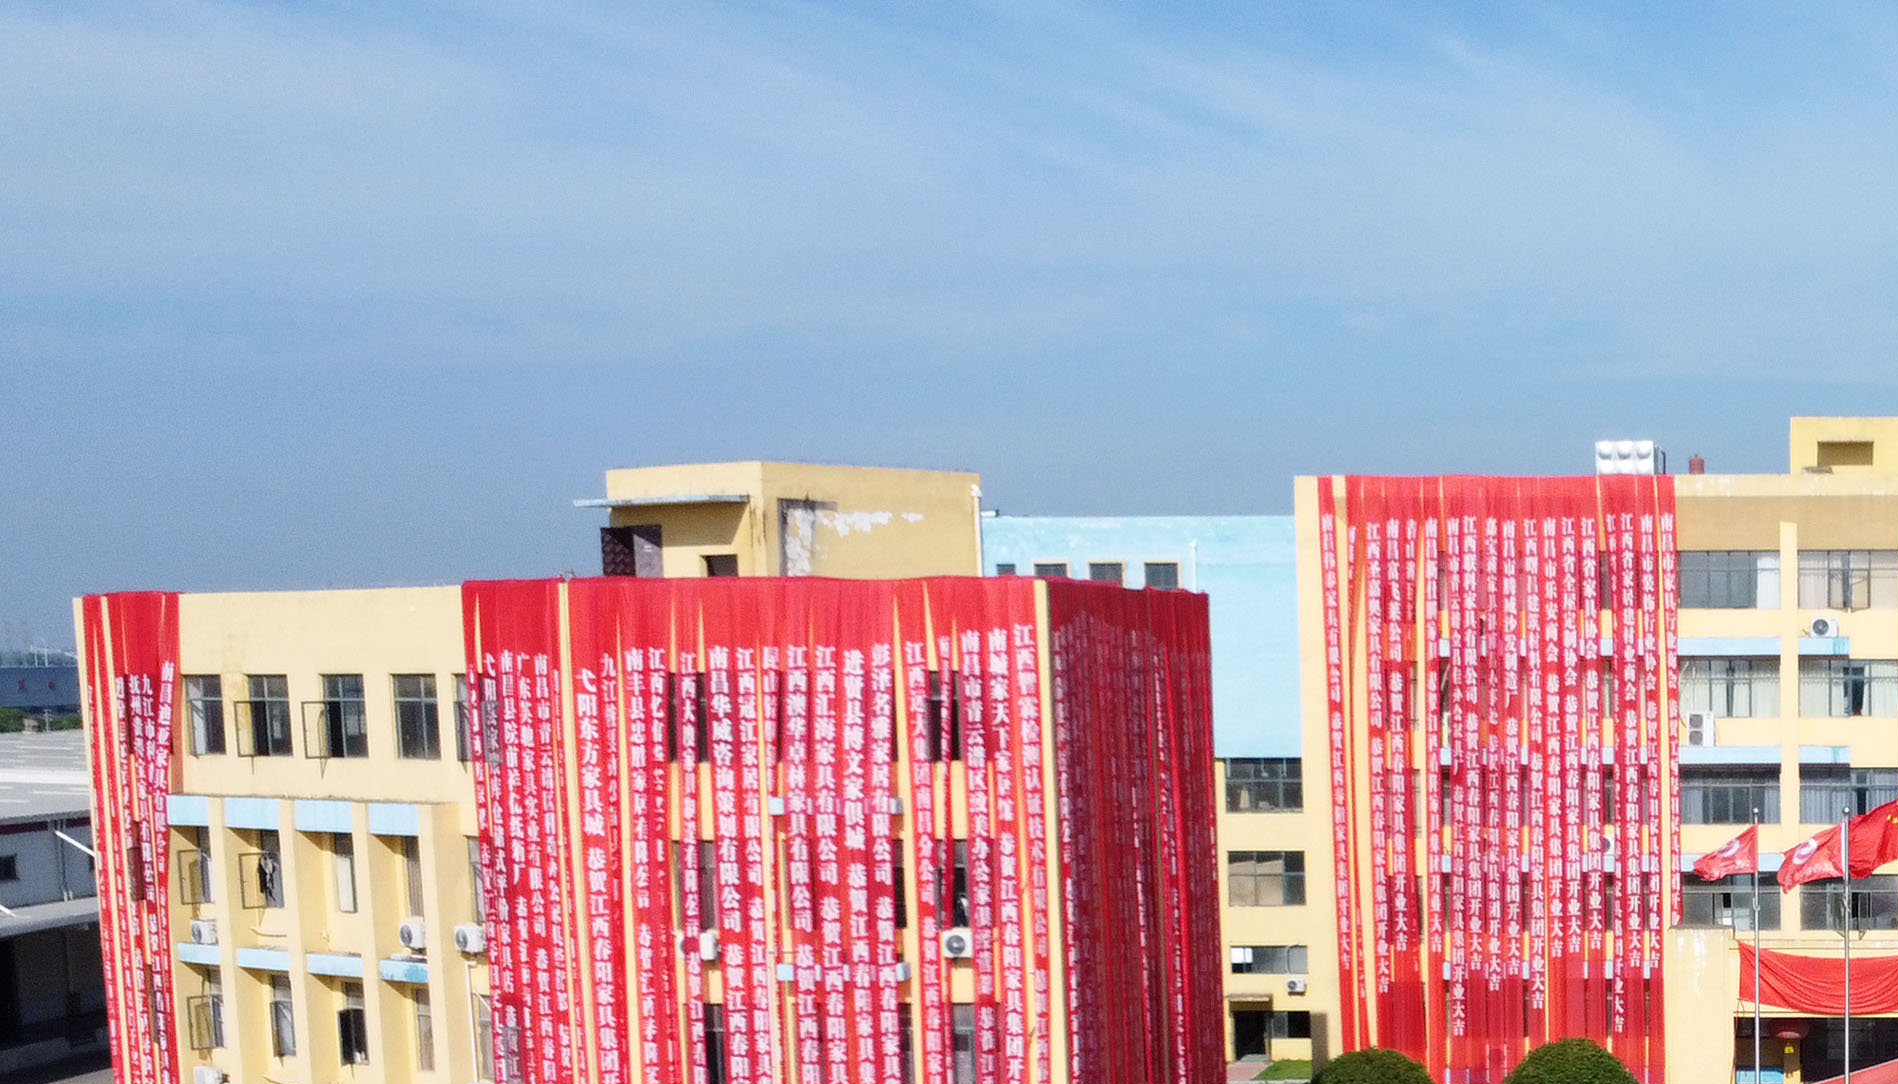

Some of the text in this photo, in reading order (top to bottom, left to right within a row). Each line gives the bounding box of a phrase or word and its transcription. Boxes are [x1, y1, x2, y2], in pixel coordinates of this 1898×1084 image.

[576, 668, 604, 836] 弋阳东方家具城
[1390, 671, 1407, 950] 恭贺江西春阳家具集团开业大吉
[1465, 712, 1483, 969] 恭贺江西春阳家具集团开业大吉
[1505, 717, 1520, 974] 恭贺江西春阳家具集团开业大吉
[1546, 672, 1564, 957] 恭贺江西春阳家具集团开业大吉
[1564, 694, 1581, 952] 恭贺江西春阳家具集团开业大吉
[1581, 516, 1602, 949] 江西省家具协会 恭贺江西春阳家具集团开业大吉
[1625, 709, 1641, 967] 恭贺江西春阳家具集团开业大吉
[1646, 701, 1661, 967] 恭贺江西春阳家具集团开业大吉
[1370, 737, 1390, 992] 恭贺江西春阳家具集团开业大吉
[1452, 785, 1465, 1035] 恭贺江西春阳家具集团开业大吉
[1530, 752, 1544, 1008] 恭贺江西春阳家具集团开业大吉
